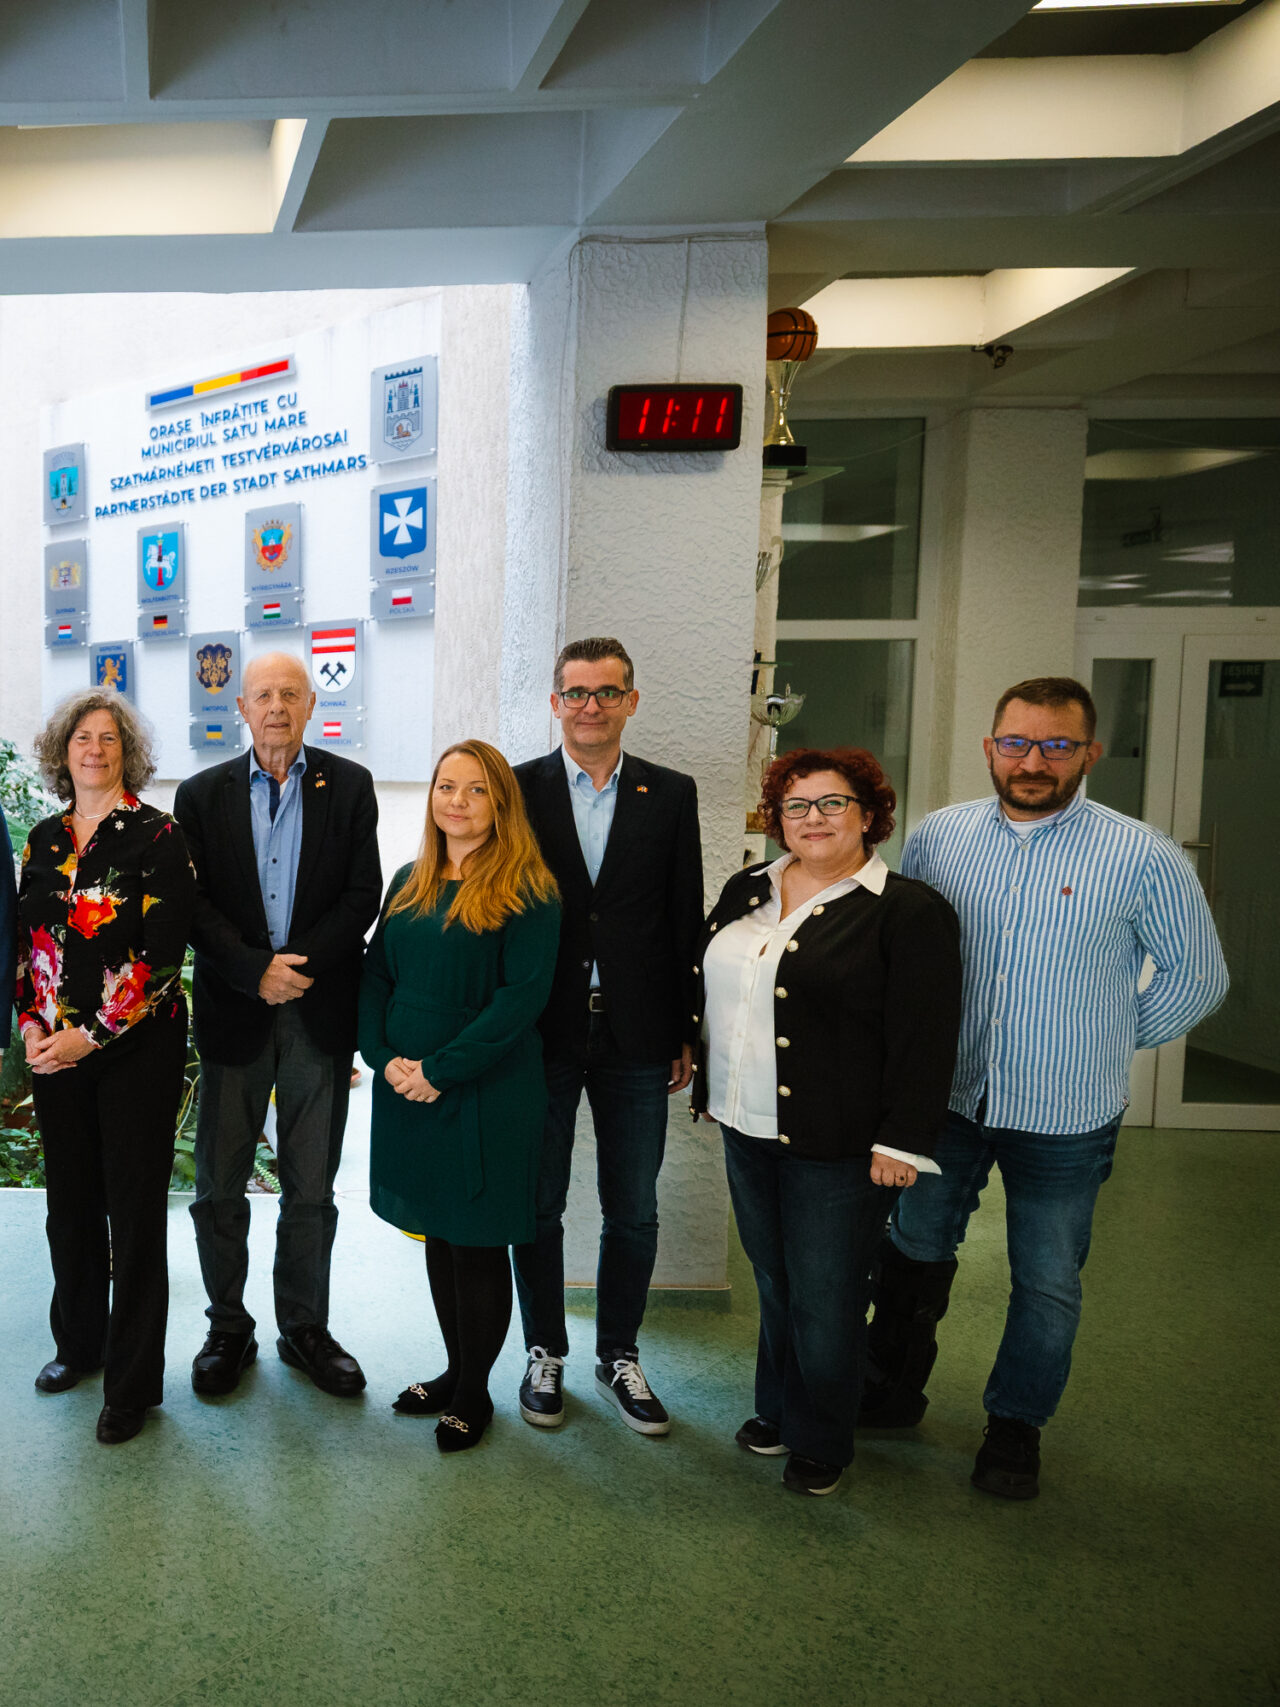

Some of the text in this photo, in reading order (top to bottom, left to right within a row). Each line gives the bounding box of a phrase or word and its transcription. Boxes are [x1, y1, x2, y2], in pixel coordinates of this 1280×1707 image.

[276, 391, 299, 409] CU
[638, 397, 728, 434] 11:11
[141, 410, 308, 459] MUNICIPIUL SATU MARE
[109, 430, 349, 491] SZATMÁRNÉMETI TESTVÉRVÁROSAI
[199, 482, 227, 499] DER
[232, 472, 278, 493] STADT
[282, 453, 368, 484] SATHMARS
